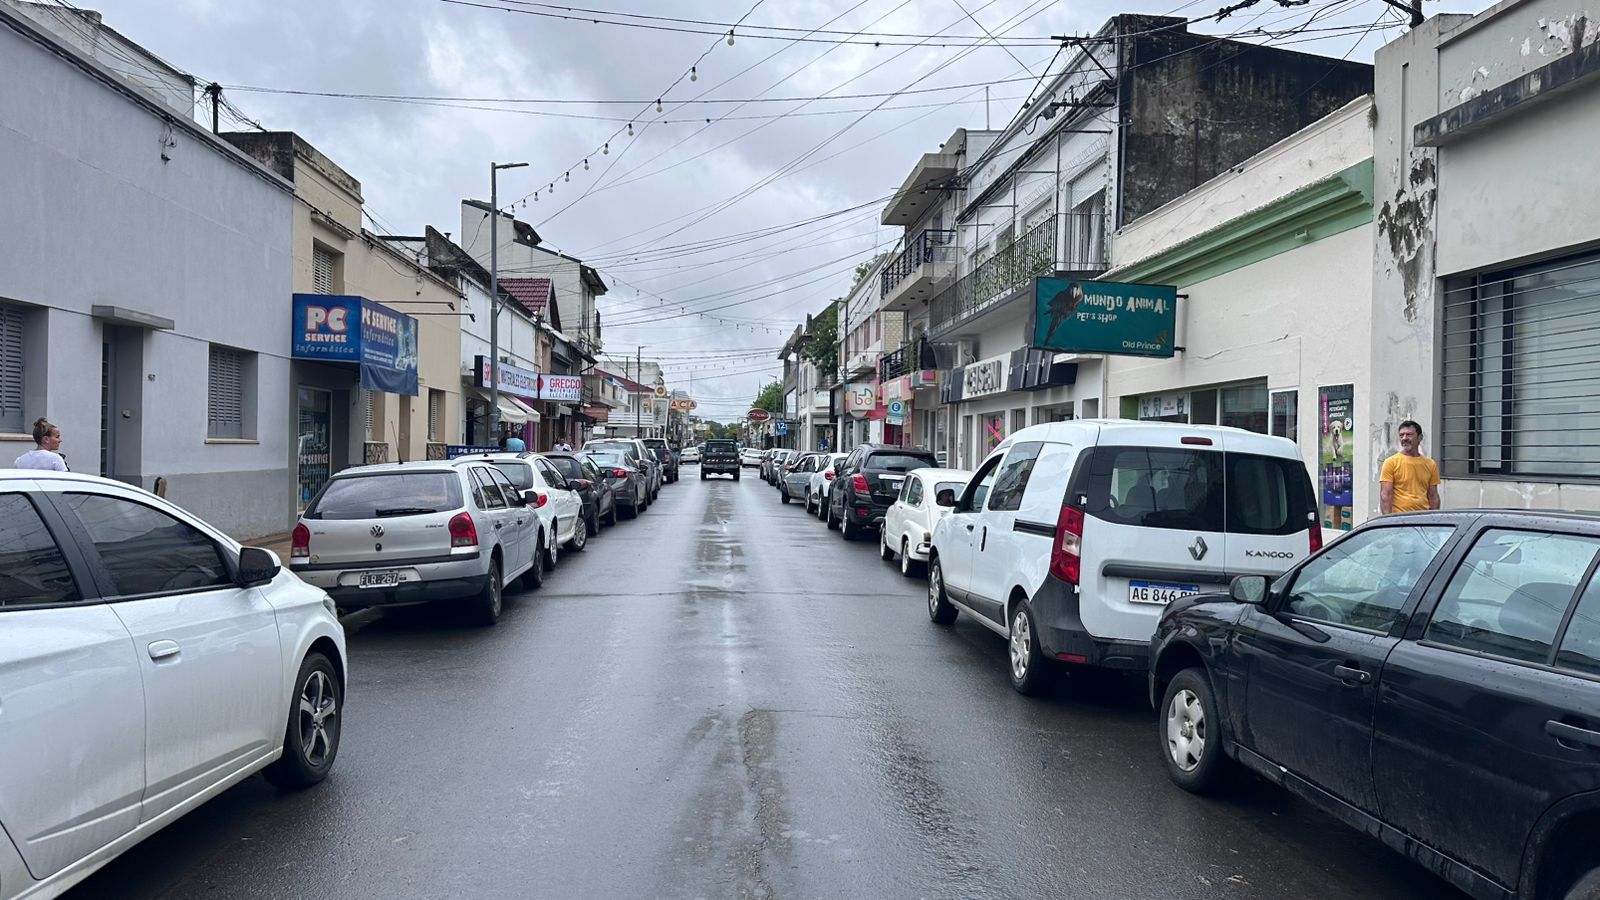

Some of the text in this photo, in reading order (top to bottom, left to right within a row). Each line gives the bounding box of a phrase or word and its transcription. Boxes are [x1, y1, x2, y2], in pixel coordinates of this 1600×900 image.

[1084, 294, 1170, 315] MUNDO ANIMAL
[307, 306, 348, 332] PC
[361, 307, 397, 334] PC SERVICE
[1097, 313, 1118, 323] SHOP
[305, 333, 347, 343] SERVICE
[1122, 340, 1161, 350] Old Prince
[550, 378, 581, 389] GRECCO
[308, 453, 328, 464] SERVICE
[1245, 550, 1294, 559] KANGOO
[1132, 587, 1149, 601] AG
[1152, 589, 1177, 602] 846
